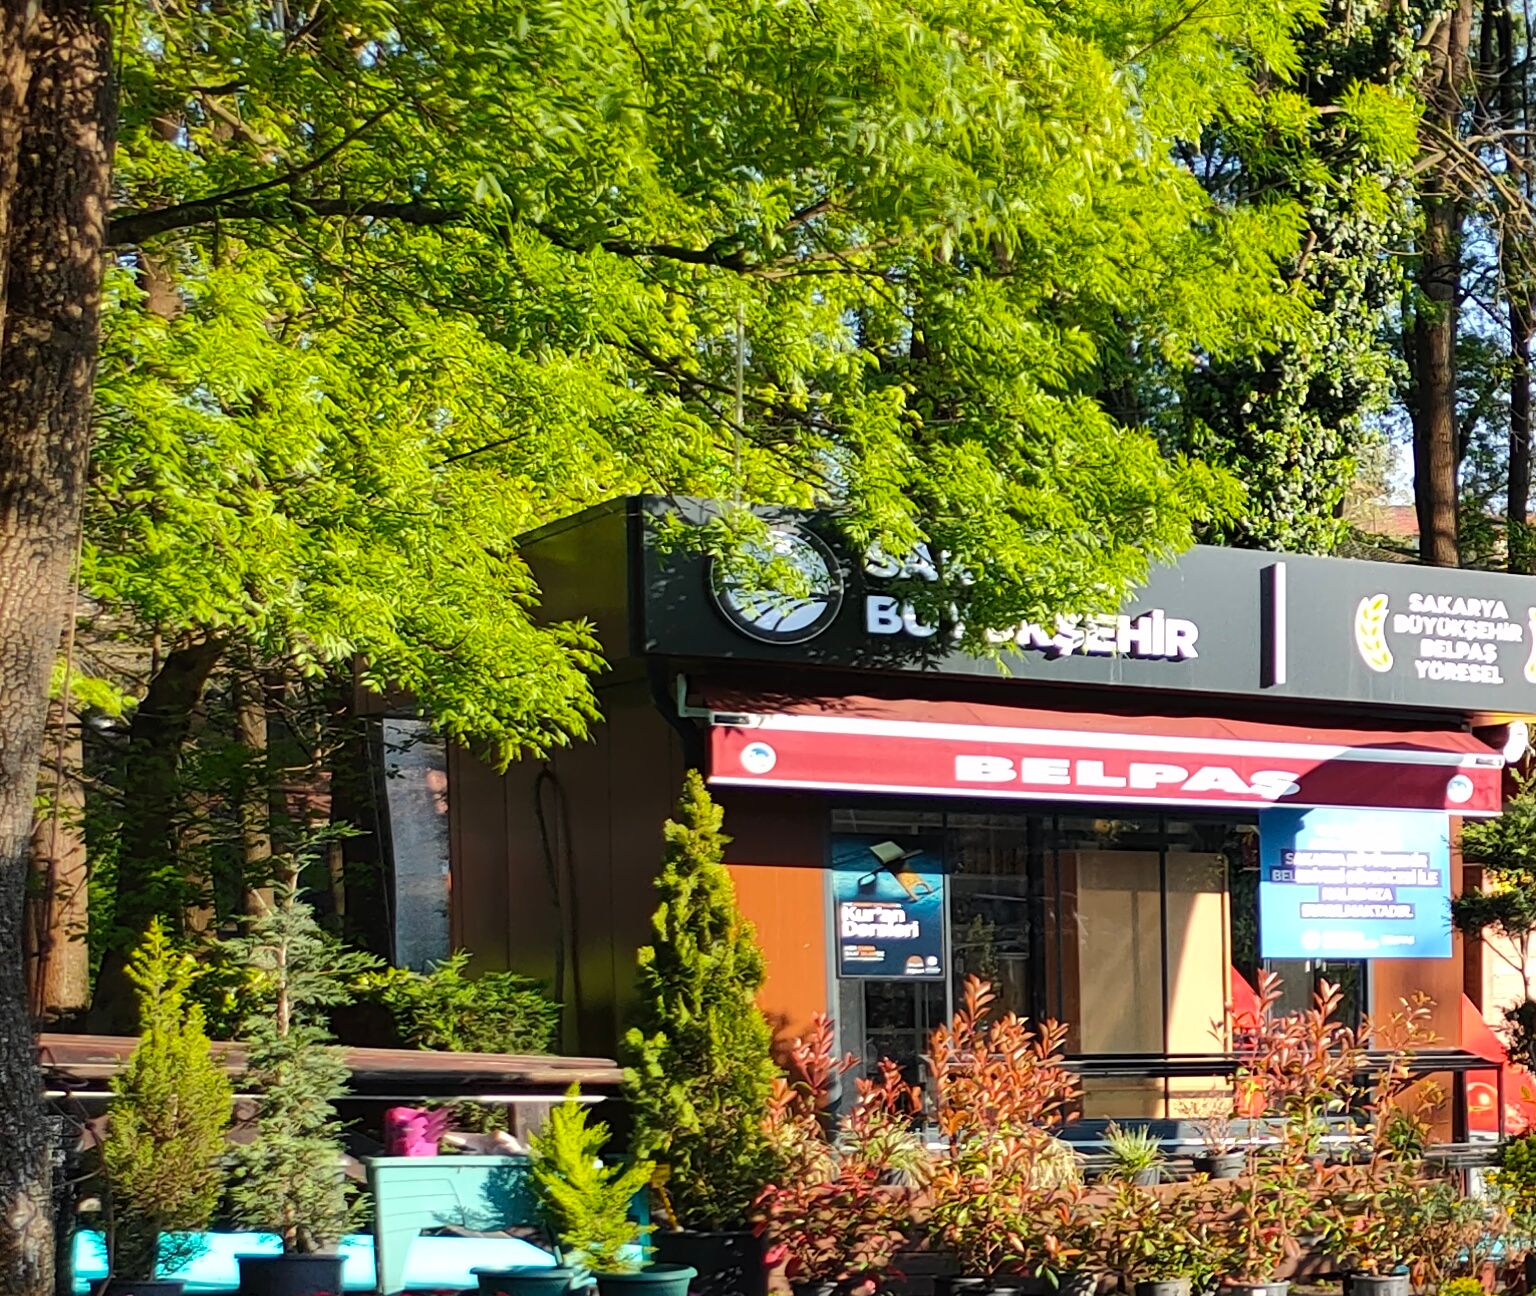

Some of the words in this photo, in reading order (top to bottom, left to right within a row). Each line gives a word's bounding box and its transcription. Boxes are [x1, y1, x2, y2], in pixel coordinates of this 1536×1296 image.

[1409, 593, 1508, 619] SAKARYA
[866, 595, 1199, 660] BKŞEHİR
[1394, 614, 1522, 642] BÜYÜKŞEHİR
[1421, 638, 1498, 664] BELPAŞ
[1414, 660, 1504, 684] YÖRESEL
[954, 755, 1301, 800] BELPAŞ
